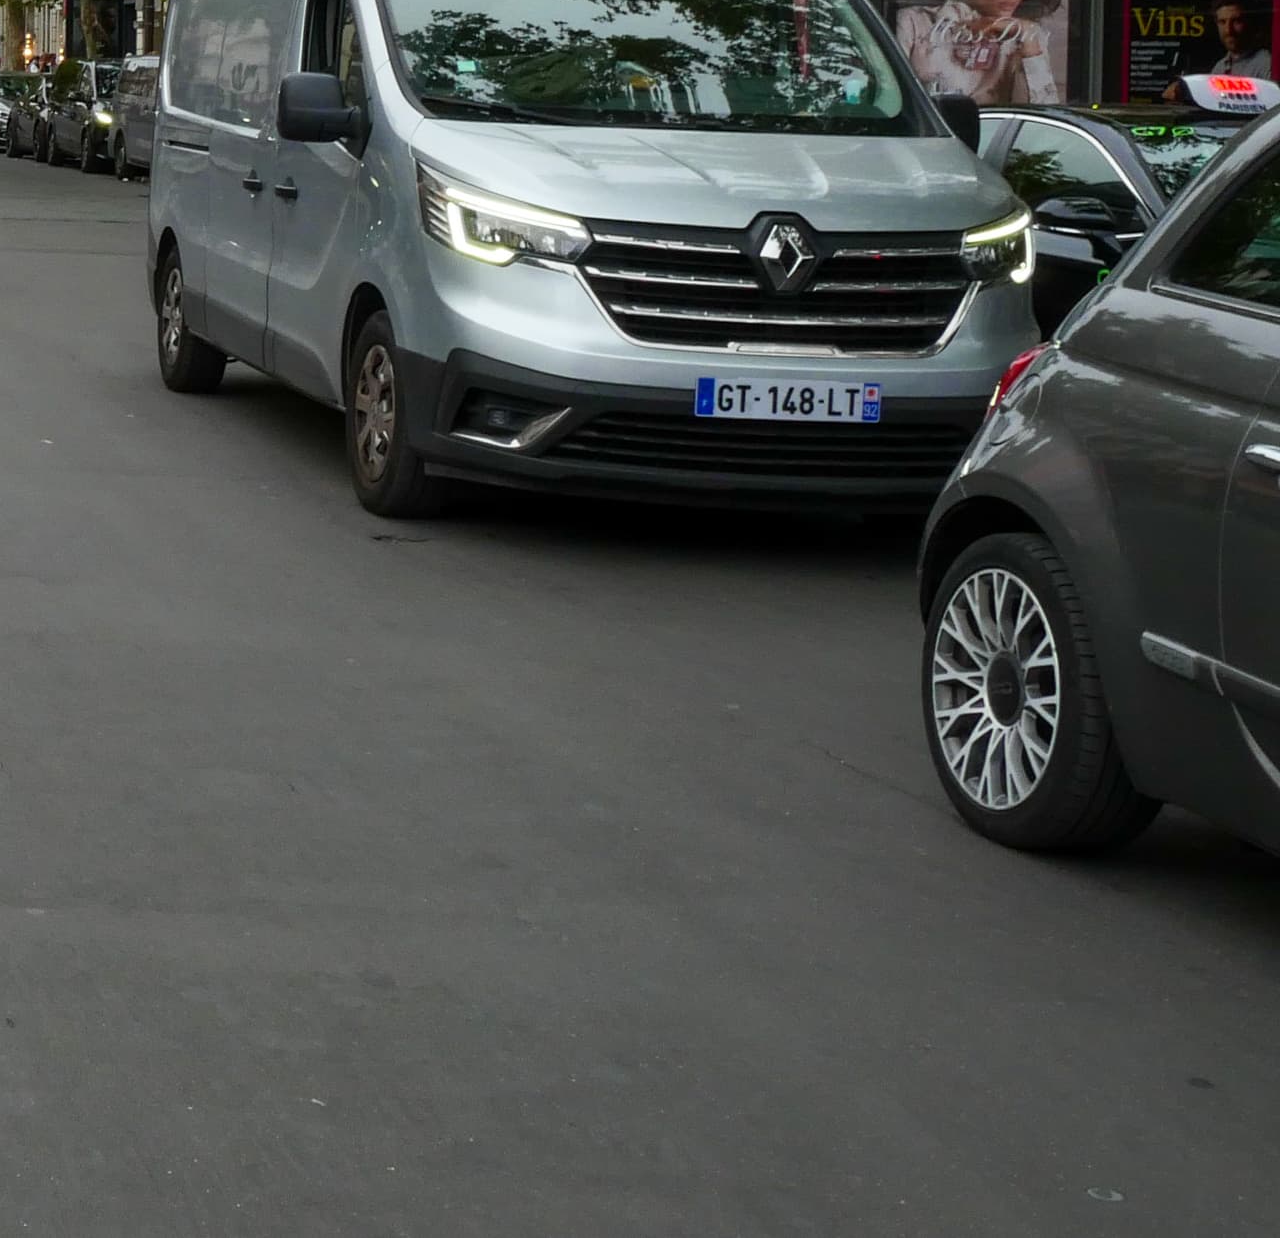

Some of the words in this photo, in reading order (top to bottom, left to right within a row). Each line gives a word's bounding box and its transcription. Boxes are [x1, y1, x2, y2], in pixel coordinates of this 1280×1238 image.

[929, 16, 985, 43] Miss
[1132, 8, 1205, 37] Vins
[717, 384, 861, 417] GT-148-LT
[863, 404, 878, 418] 92
